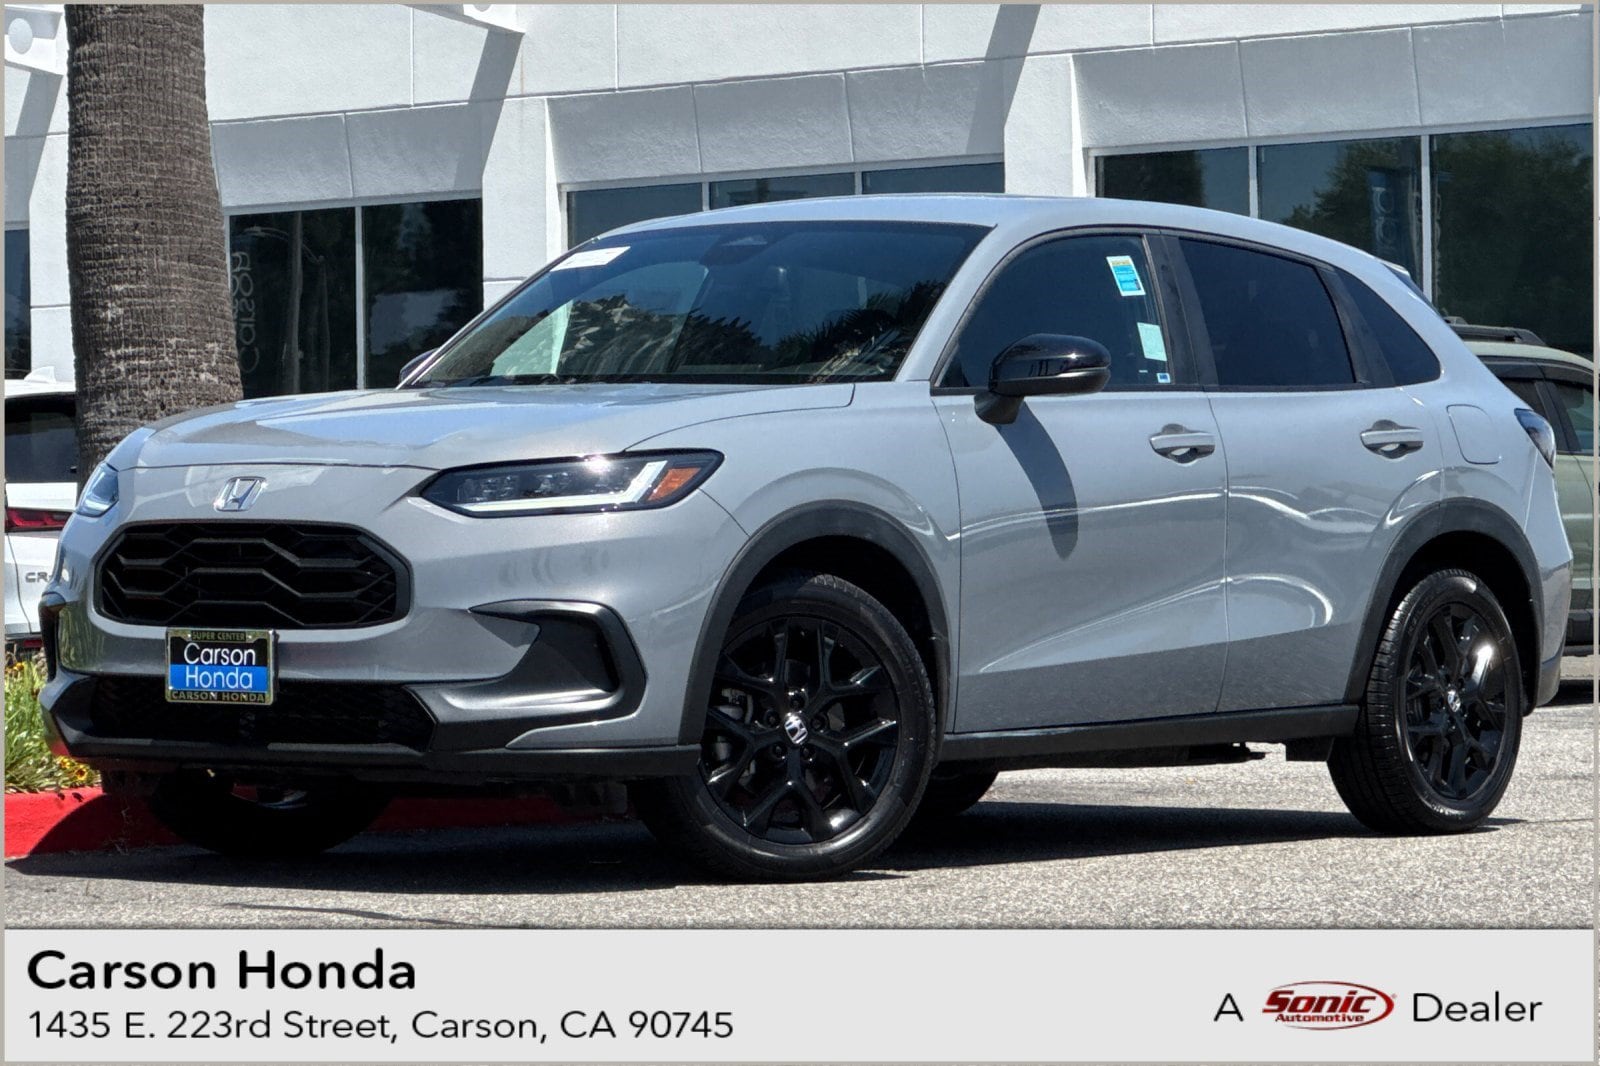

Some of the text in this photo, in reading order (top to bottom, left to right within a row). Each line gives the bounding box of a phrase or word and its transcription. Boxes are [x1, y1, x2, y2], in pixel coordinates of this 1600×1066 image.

[193, 632, 246, 641] SUPER CENTER
[183, 642, 256, 666] Carson
[185, 665, 253, 689] Honda
[171, 690, 265, 702] CARSON HONDA
